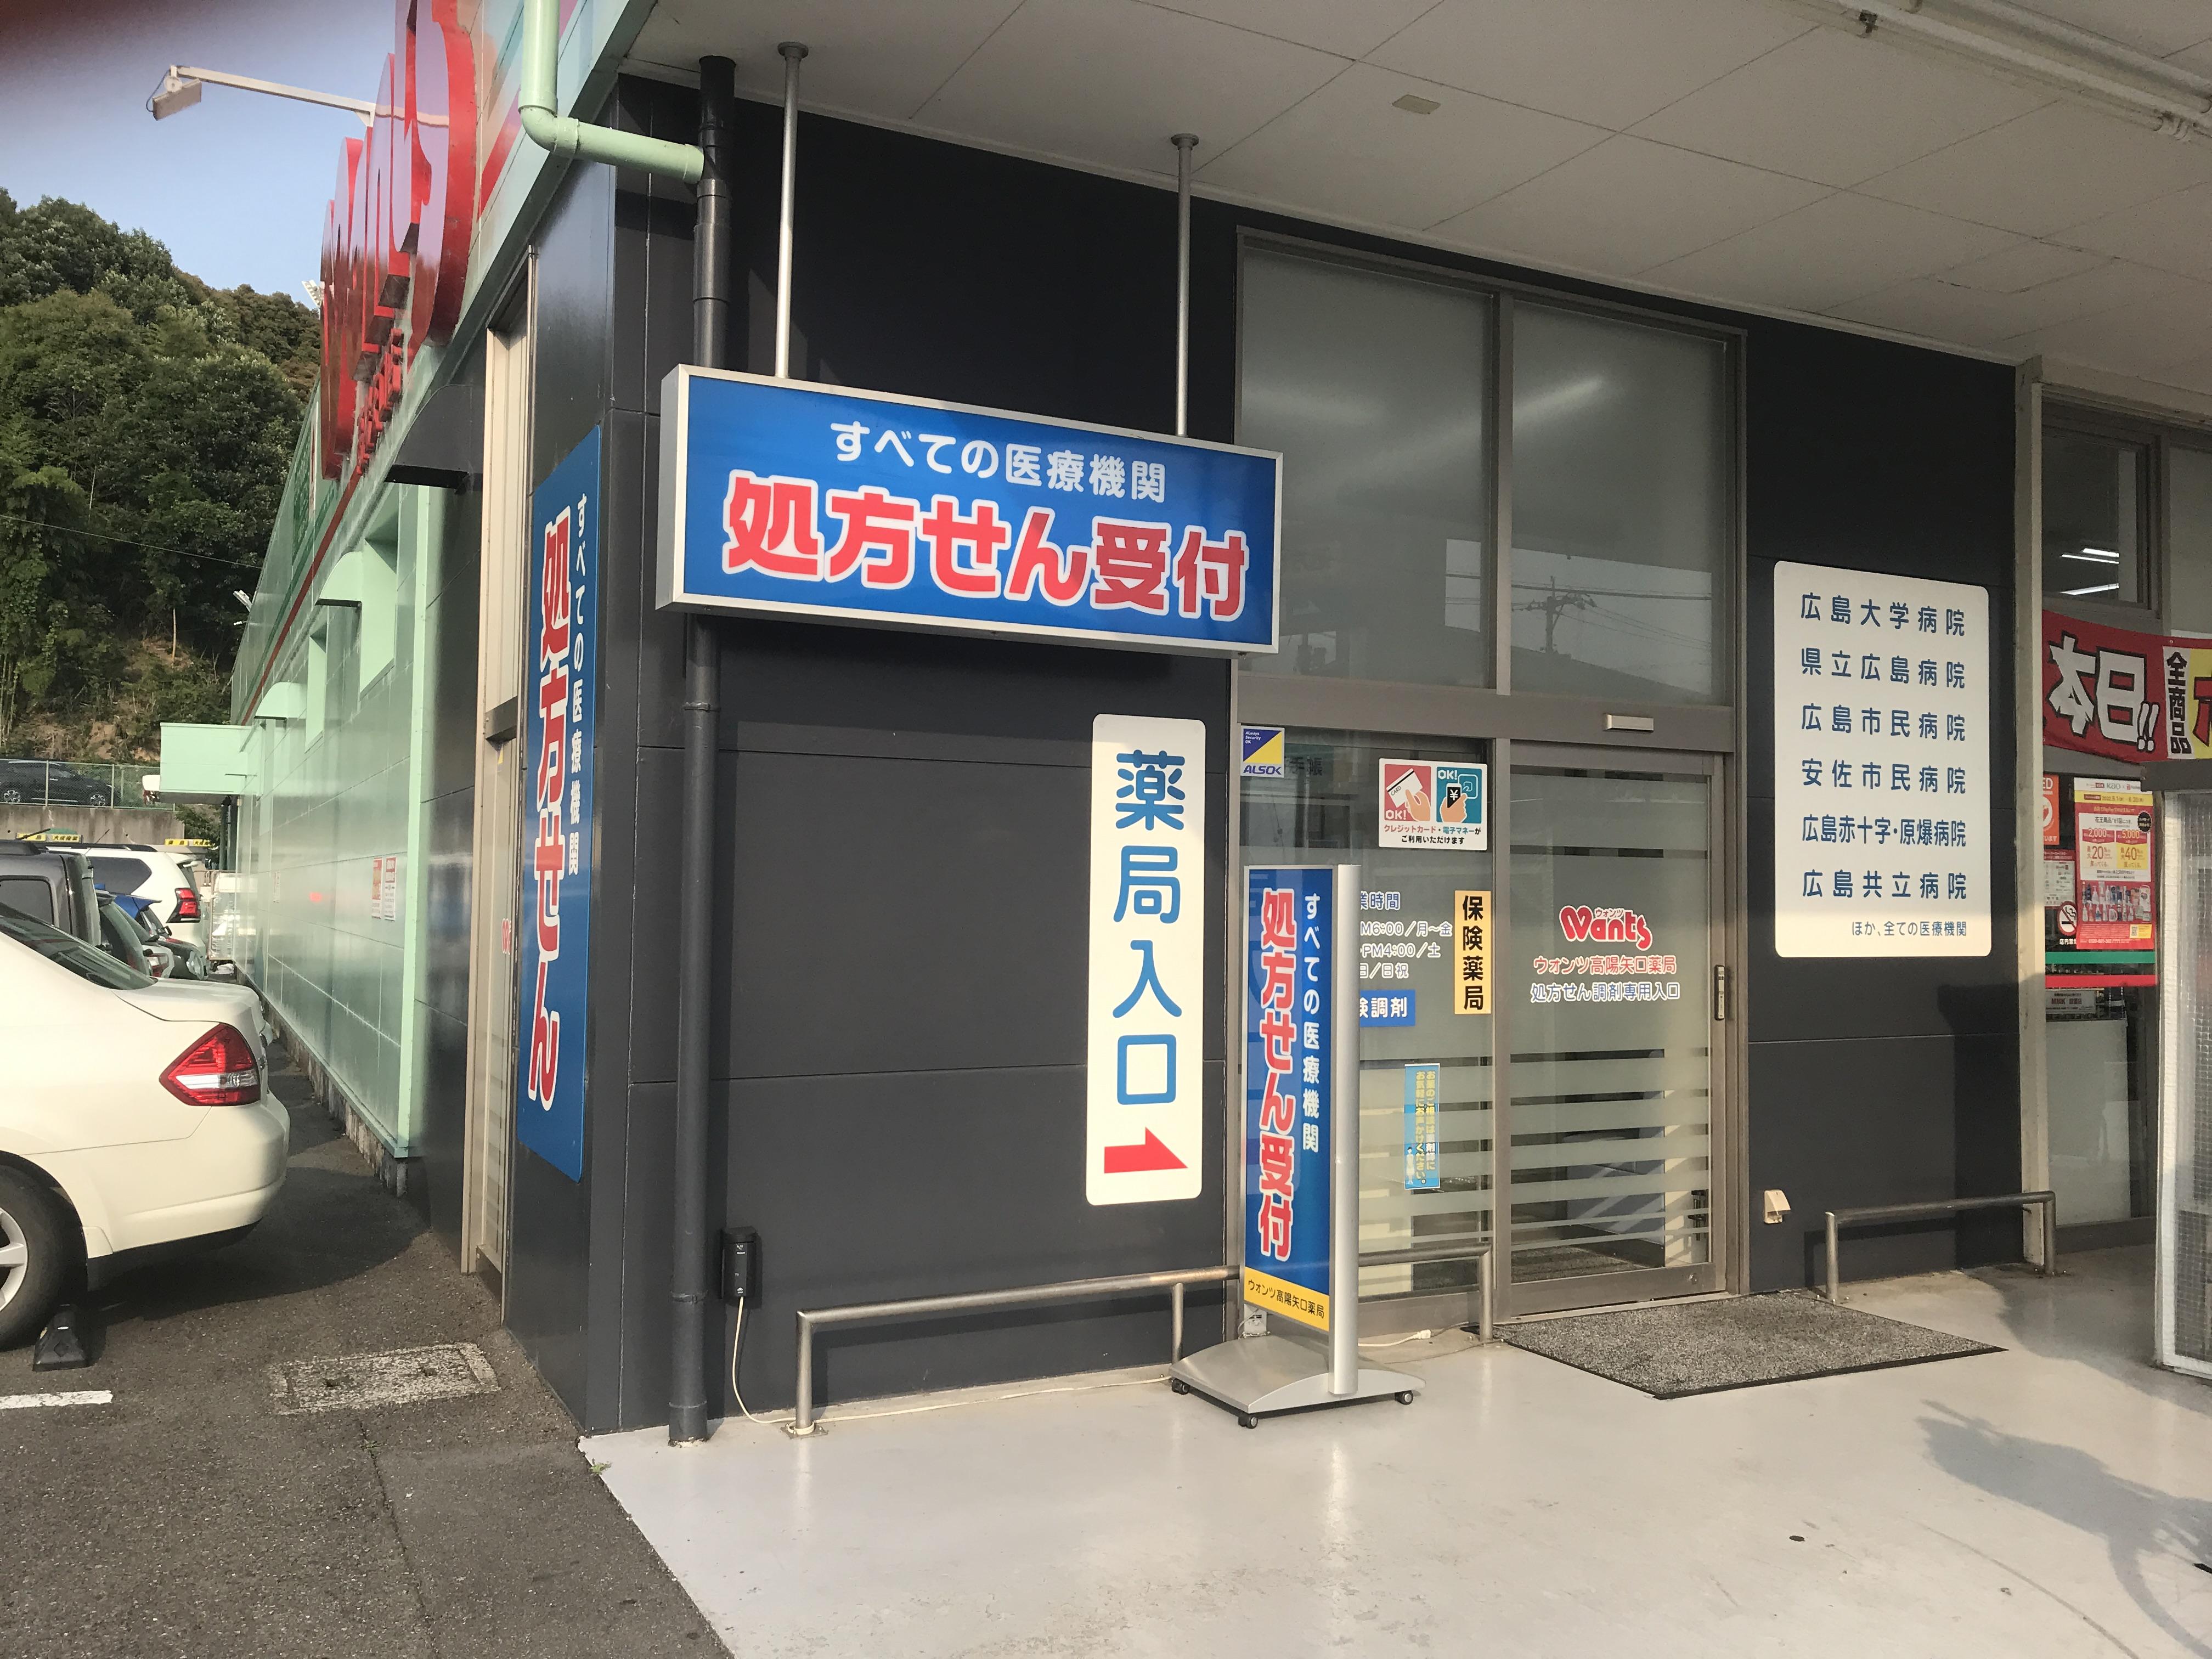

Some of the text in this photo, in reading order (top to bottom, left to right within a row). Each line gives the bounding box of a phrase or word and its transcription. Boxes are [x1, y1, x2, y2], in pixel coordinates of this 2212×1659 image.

[831, 421, 1165, 504] すべての医療機関
[722, 470, 1248, 622] 処方せん受付
[1801, 592, 1966, 637] 広島大学病院
[569, 493, 587, 876] すべての医療機関
[1801, 647, 1966, 689] 県立広島病院
[1801, 703, 1966, 742] 広島市民病院
[2166, 651, 2192, 754] 全商品
[1243, 765, 1282, 775] ALSOK
[1437, 769, 1458, 780] OK!
[1802, 758, 1966, 795] 安佐市民病院
[528, 505, 571, 1111] 処方せん
[1390, 786, 1402, 796] CARD
[1384, 825, 1481, 835] クレジットカード・電子マネーが
[1385, 809, 1407, 820] OK!
[1802, 814, 1967, 848] 広島赤十字・原爆病院
[1401, 835, 1465, 845] ご利用いただけます
[1803, 869, 1967, 900] 広島共立病院
[1113, 749, 1186, 1105] 薬局入口
[1559, 905, 1652, 951] Wants
[1852, 921, 1967, 937] ほか、全ての医療機関
[1462, 895, 1484, 1011] 保険薬局
[1531, 981, 1680, 1003] 処方せん調剤専用入口
[1304, 893, 1321, 1153] すべての医療機関
[1259, 888, 1297, 1261] 処方せん受付
